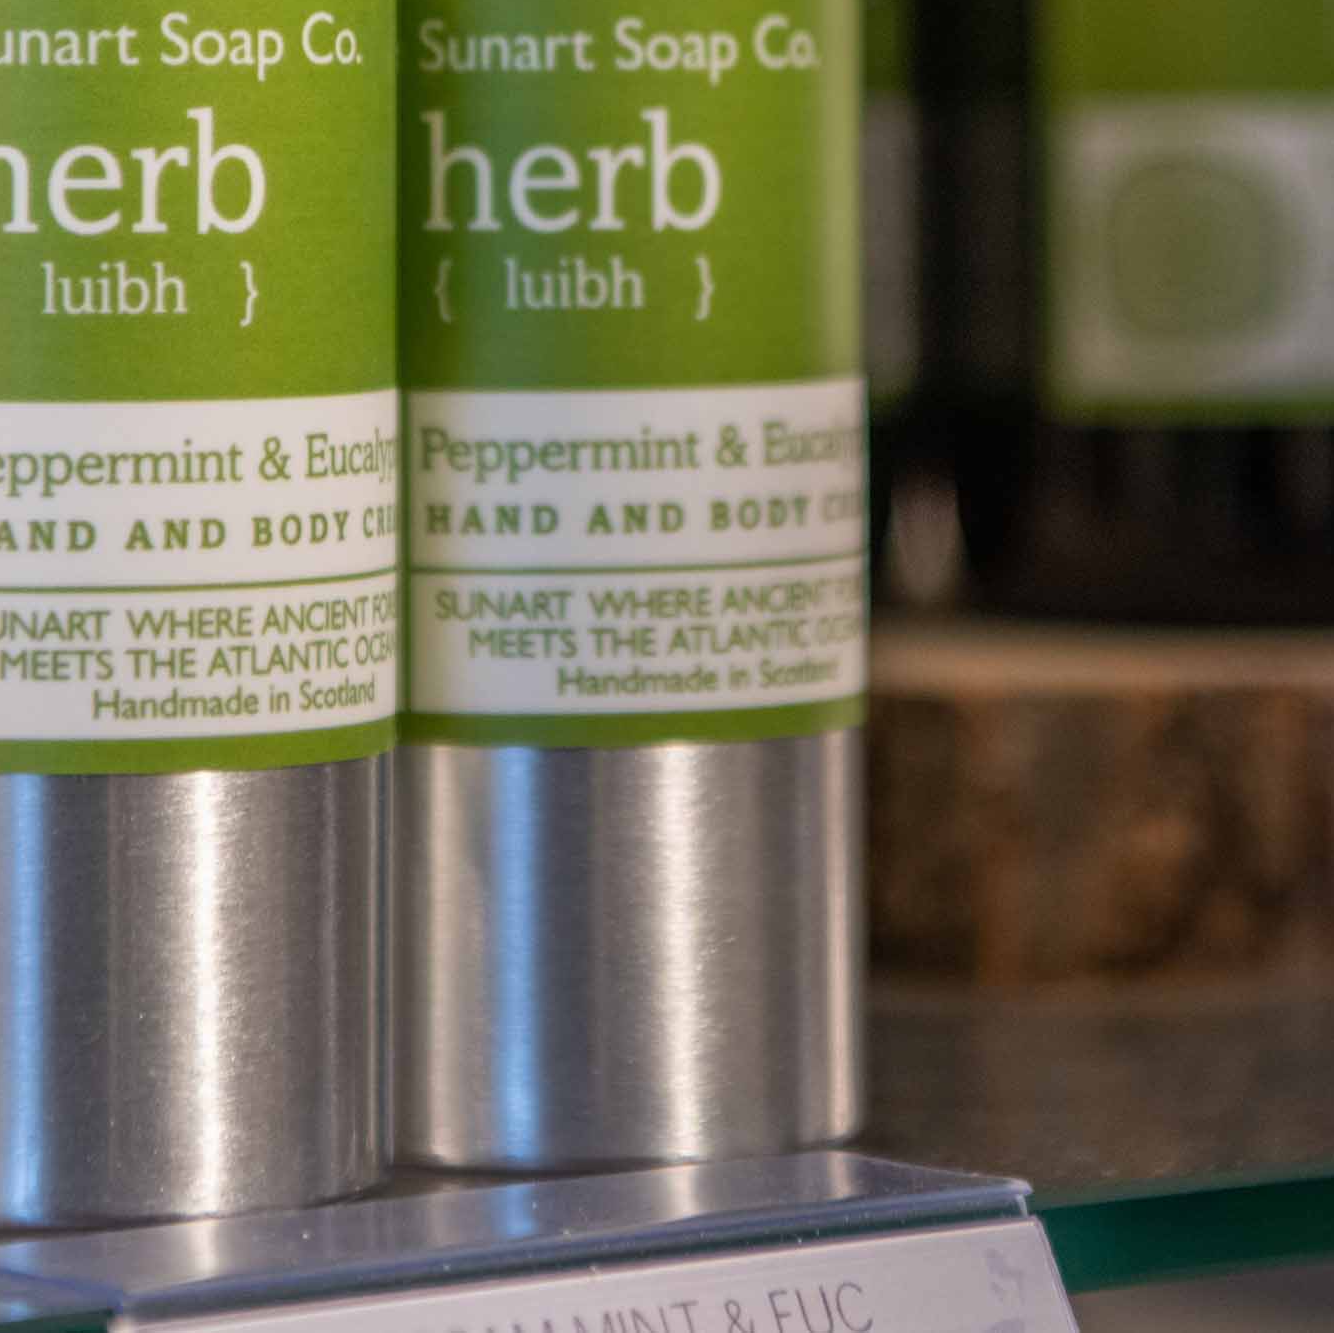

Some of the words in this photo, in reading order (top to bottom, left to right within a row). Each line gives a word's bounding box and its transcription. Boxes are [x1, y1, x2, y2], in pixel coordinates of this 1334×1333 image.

[159, 12, 283, 81] Soap
[302, 11, 364, 64] Co.
[419, 18, 594, 72] Sunart
[614, 16, 738, 88] Soap
[421, 108, 722, 233] herb
[42, 261, 187, 315] luibh
[505, 255, 646, 311] luibh
[257, 437, 291, 481] &
[419, 426, 700, 484] Peppermint
[715, 424, 748, 467] &
[125, 518, 227, 551] AND
[253, 510, 350, 547] BODY
[426, 504, 559, 535] HAND
[587, 502, 685, 535] AND
[710, 497, 810, 532] BODY
[125, 606, 253, 640] WHERE
[261, 596, 370, 635] ANCIENT
[434, 590, 573, 622] SUNART
[588, 587, 712, 618] WHERE
[469, 627, 578, 659] MEETS
[589, 626, 657, 657] THE
[667, 616, 809, 655] ATLANTIC
[0, 649, 113, 681] MEETS
[125, 648, 197, 680] THE
[207, 640, 349, 677] ATLANTIC
[557, 666, 719, 697] Handmade
[728, 663, 750, 692] in
[92, 685, 259, 721] Handmade
[269, 683, 290, 713] in
[299, 673, 375, 711] Scotland
